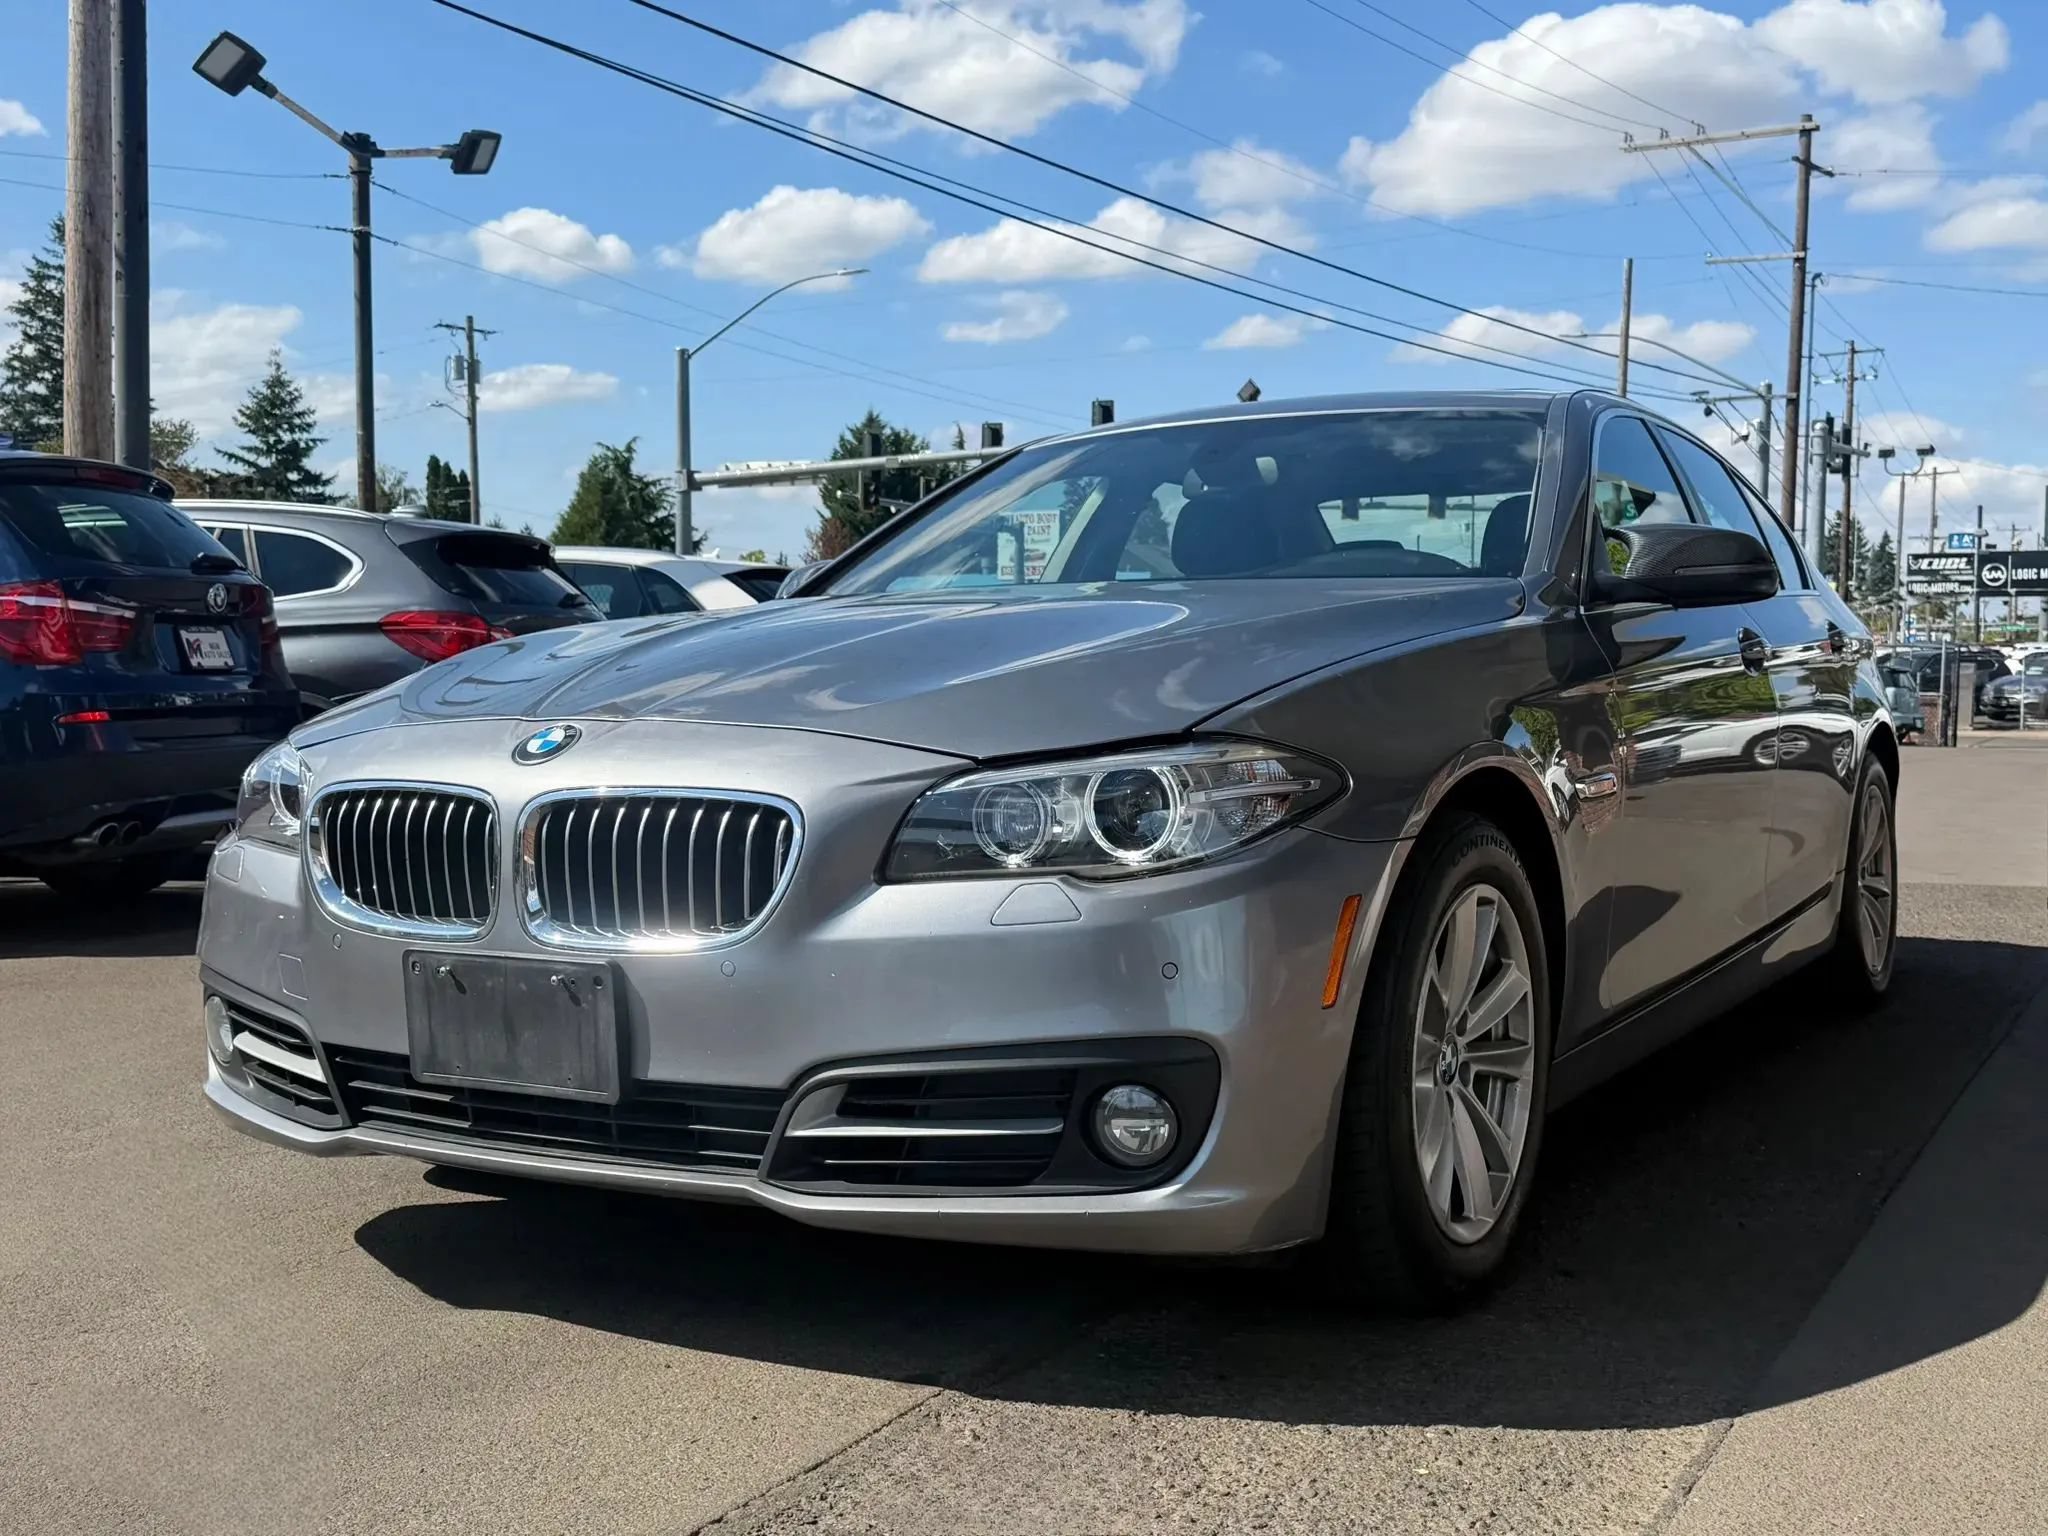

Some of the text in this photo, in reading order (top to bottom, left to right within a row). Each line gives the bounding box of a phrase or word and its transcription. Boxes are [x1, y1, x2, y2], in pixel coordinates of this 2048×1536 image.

[1037, 513, 1057, 524] BODY
[1027, 524, 1051, 536] PAINT
[2012, 568, 2038, 580] LOGIC
